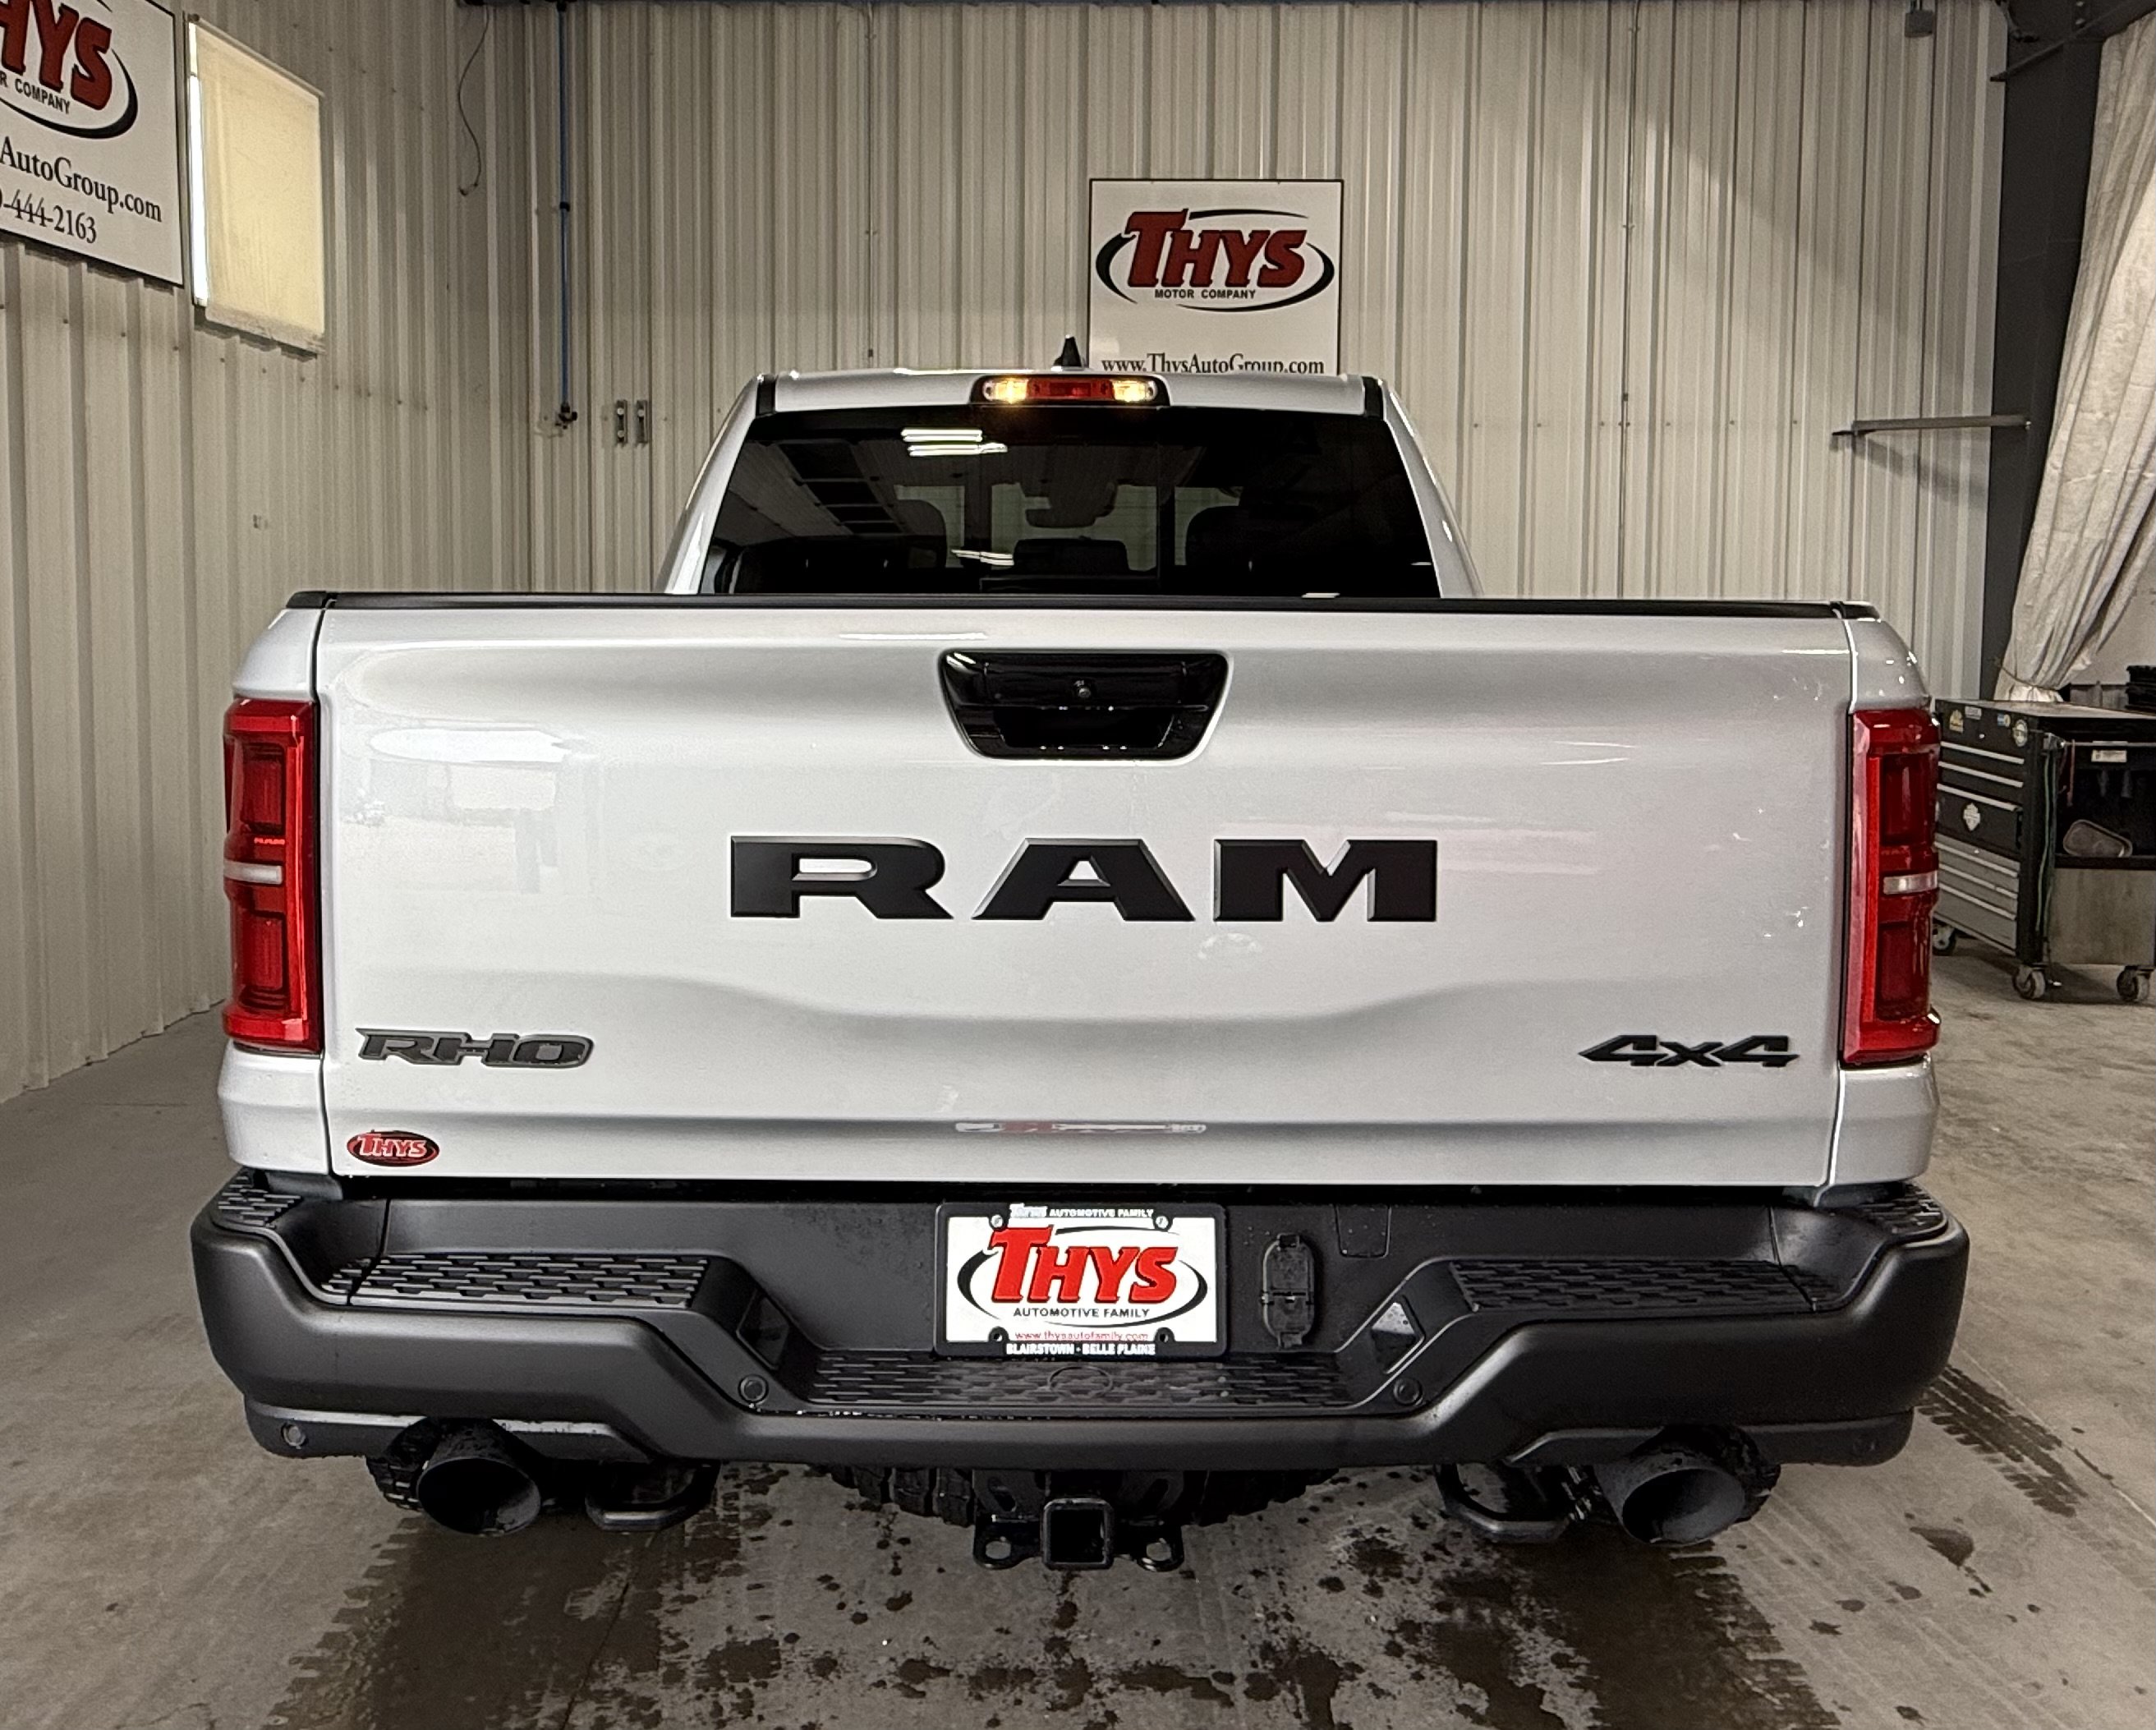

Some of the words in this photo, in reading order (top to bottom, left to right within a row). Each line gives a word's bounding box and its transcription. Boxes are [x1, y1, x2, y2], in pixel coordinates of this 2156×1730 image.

[14, 78, 71, 114] COMPANY
[0, 188, 97, 244] -444-2163
[1124, 208, 1308, 288] THYS
[1154, 288, 1195, 299] MOTOR
[1201, 288, 1257, 300] COMPANY
[730, 835, 1438, 923] RAM
[355, 1028, 595, 1069] RHO
[356, 1133, 428, 1158] THYS
[987, 1224, 1179, 1304] THYS
[1013, 1307, 1100, 1318] AUTOMOTIVE
[1103, 1308, 1150, 1318] FAMILY
[1006, 1343, 1075, 1355] BLAIRSTOWN
[1082, 1343, 1116, 1355] BELLE
